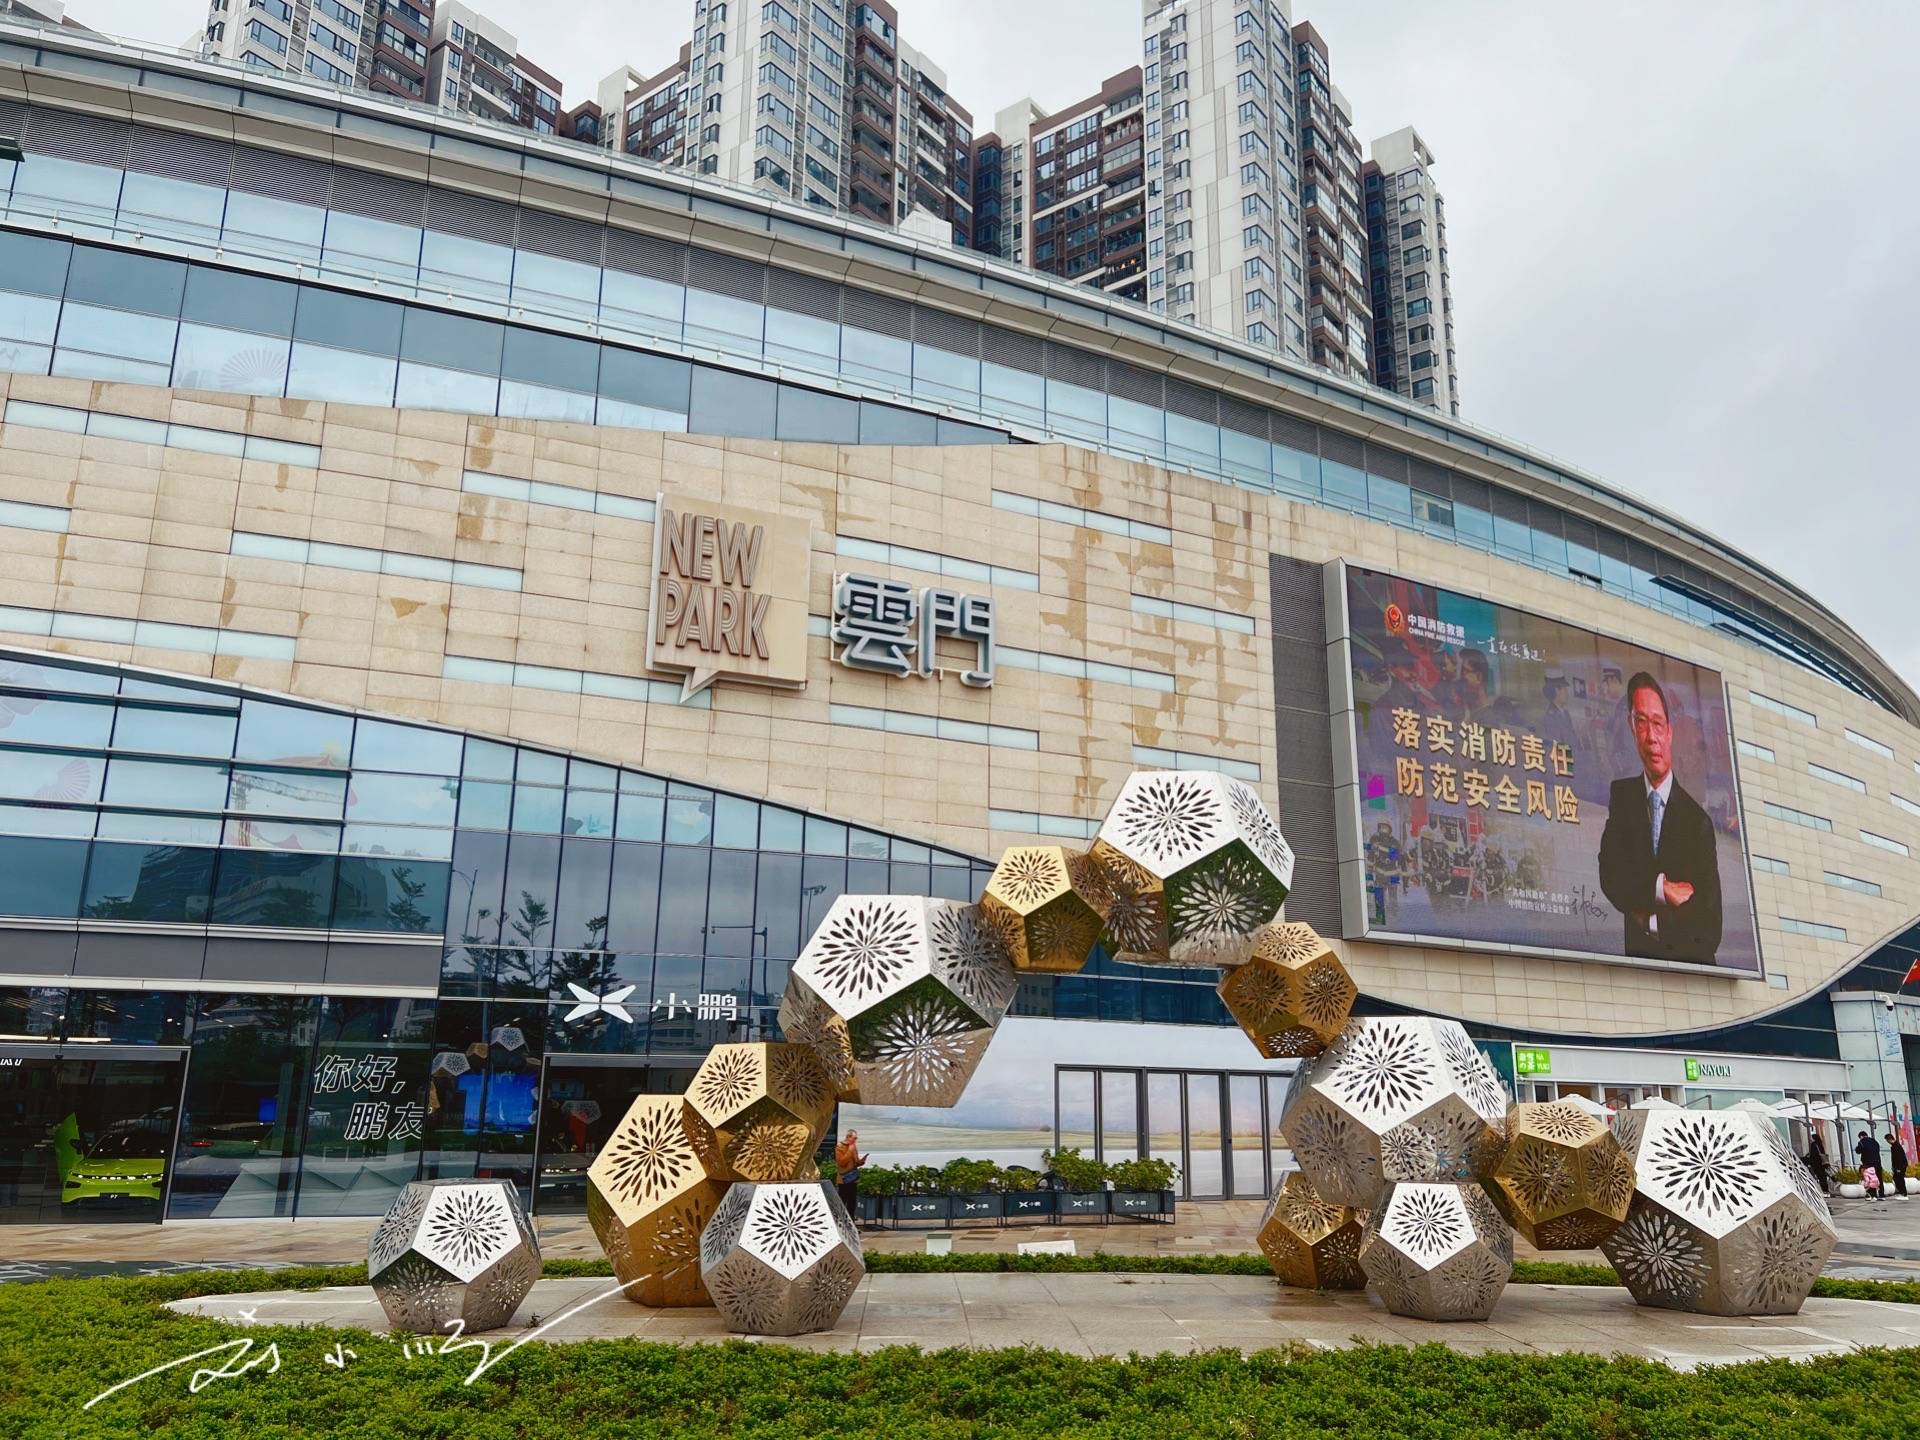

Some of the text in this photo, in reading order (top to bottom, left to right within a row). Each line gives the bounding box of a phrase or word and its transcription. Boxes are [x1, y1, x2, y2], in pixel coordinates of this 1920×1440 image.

[660, 509, 764, 588] NEW
[656, 577, 772, 660] PARK
[831, 572, 995, 688] 雲門
[1391, 707, 1575, 778] 落实消防责任
[1396, 756, 1581, 824] 防范安全风险
[651, 992, 737, 1021] 小鹏
[1699, 1064, 1731, 1077] NAYUKI
[344, 1101, 432, 1140] 鹏友
